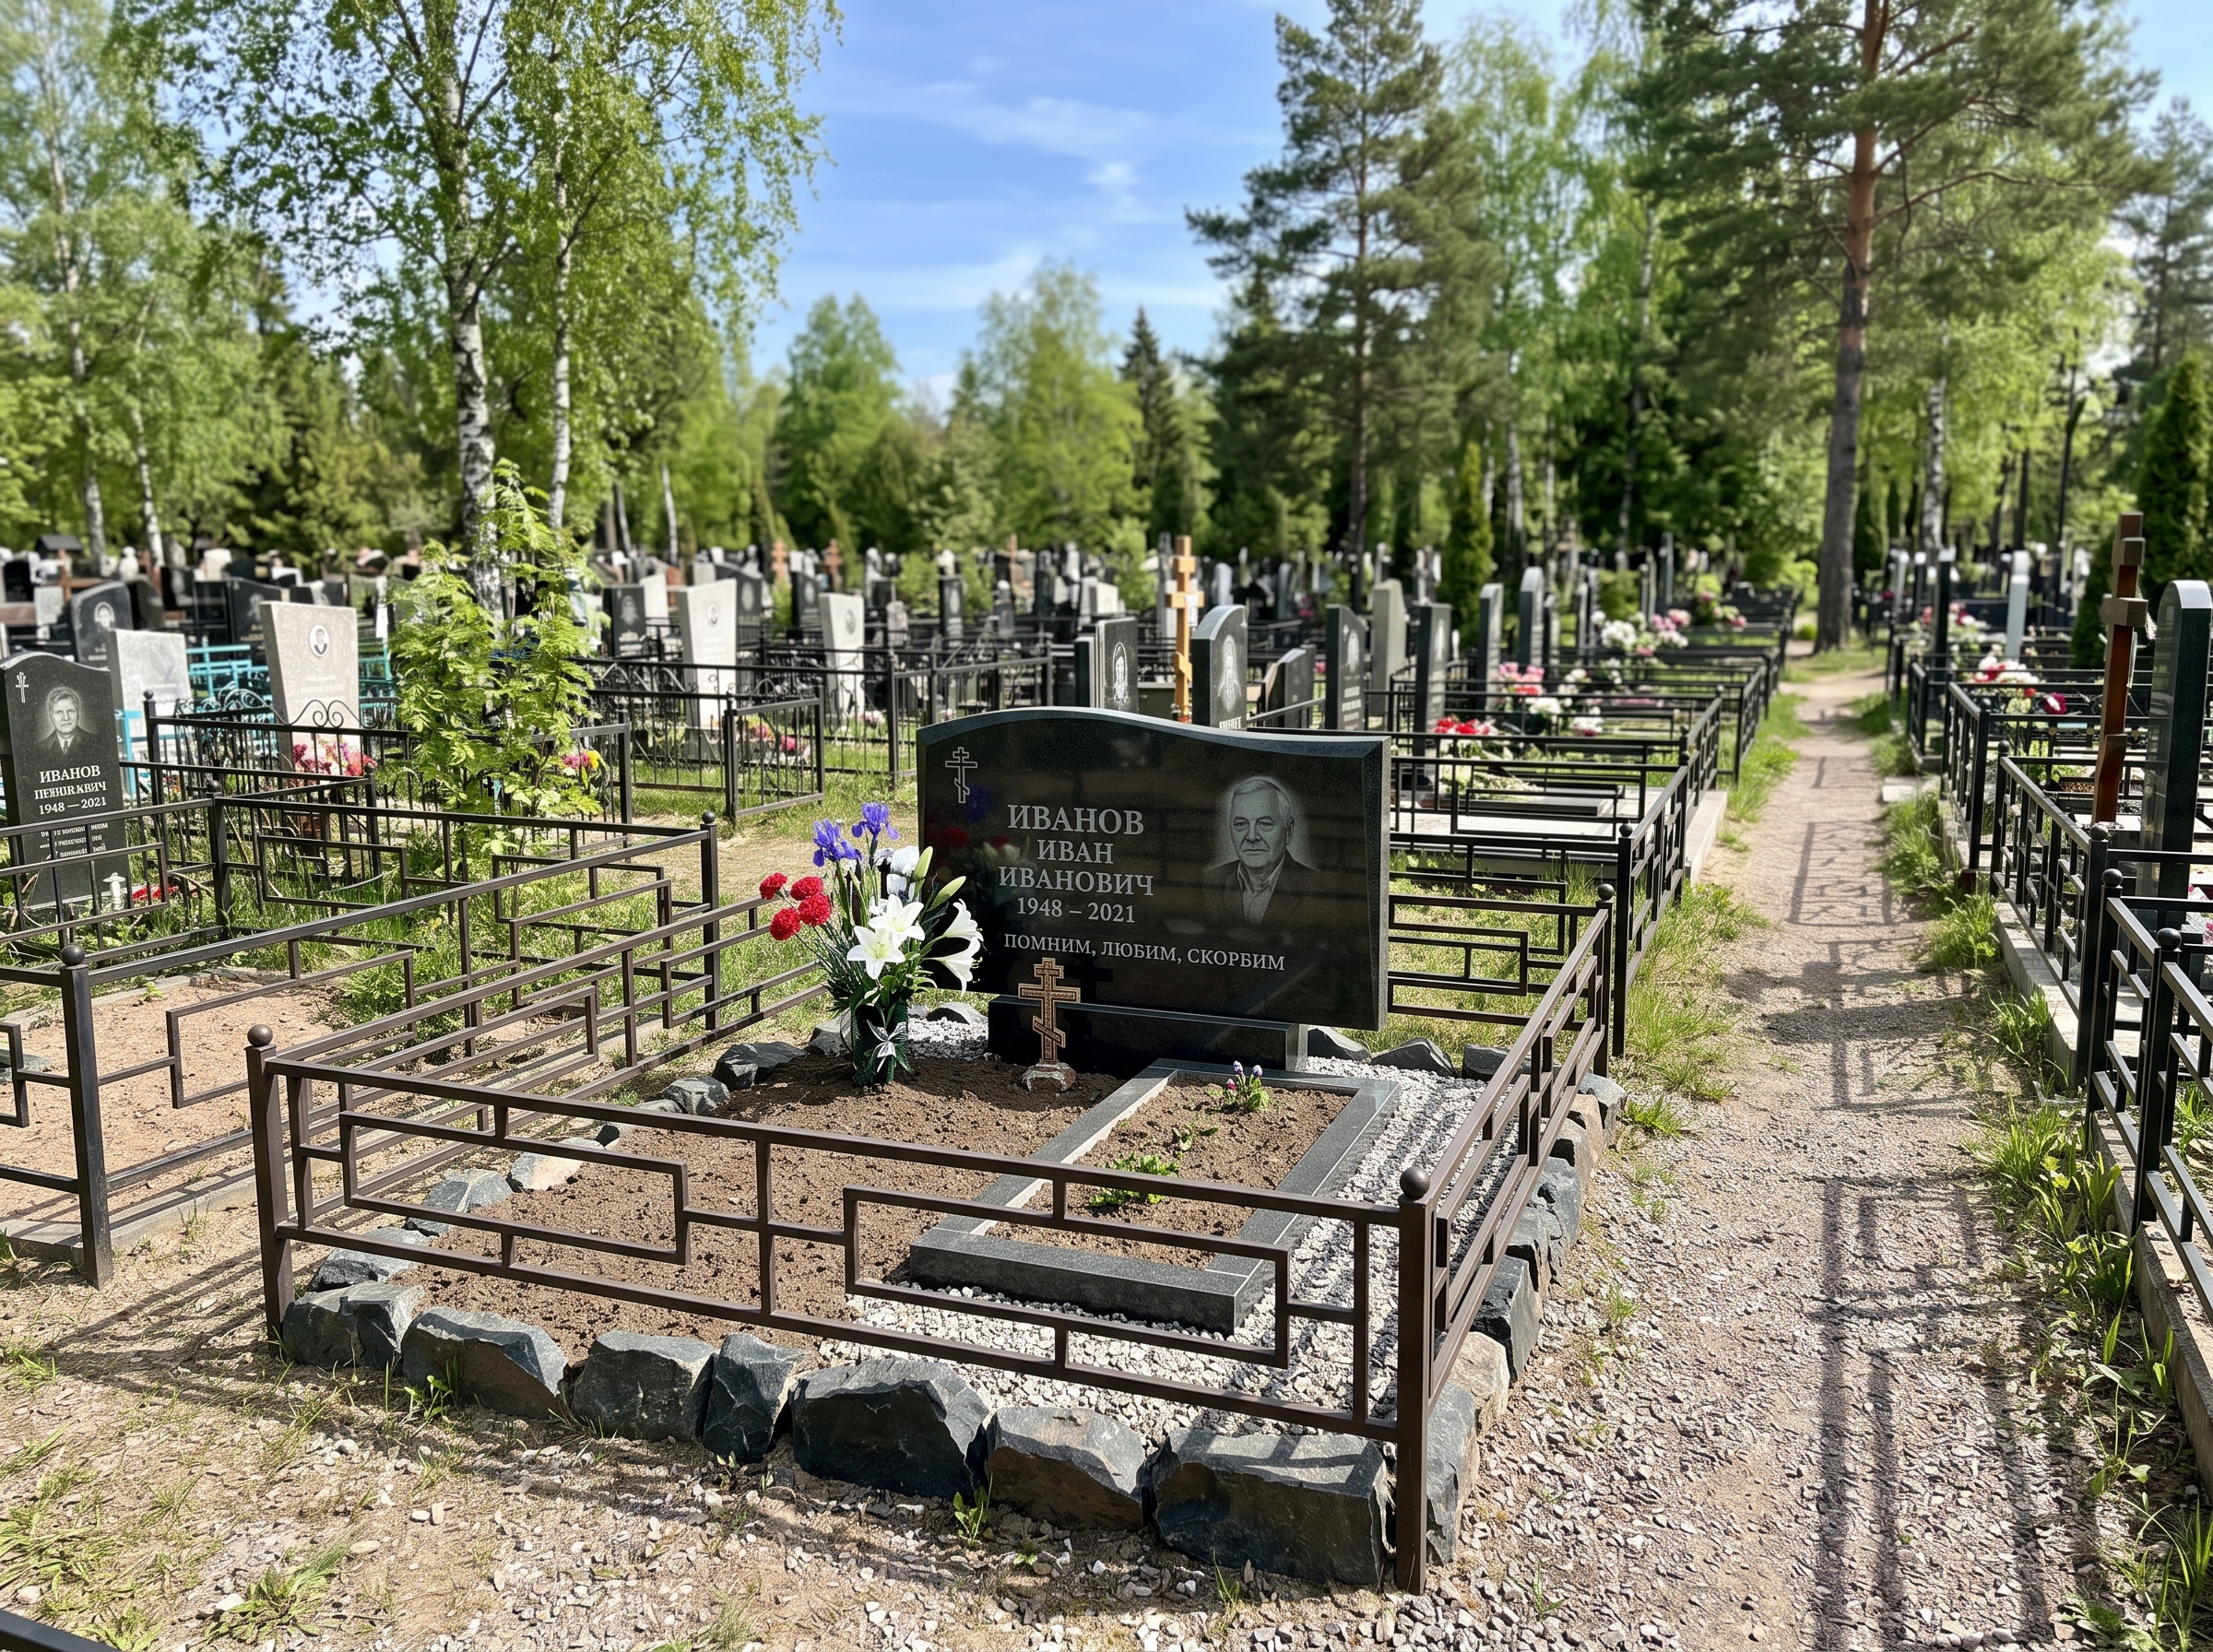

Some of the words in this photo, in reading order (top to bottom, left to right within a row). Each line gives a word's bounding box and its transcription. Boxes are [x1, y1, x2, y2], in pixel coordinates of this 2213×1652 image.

[39, 765, 101, 784] ИВАНОВ
[39, 802, 65, 815] 1948
[80, 796, 107, 808] 2021
[1007, 804, 1144, 835] ИВАНОВ
[1036, 839, 1114, 865] ИВАН
[998, 866, 1154, 896] ИВАНОВИЧ
[1017, 897, 1063, 917] 1948
[1087, 902, 1135, 923] 2021
[1004, 933, 1096, 957] ПОМНИМ,
[1101, 941, 1182, 964] ЛЮБИМ,
[1187, 948, 1285, 971] СКОРБИМ
